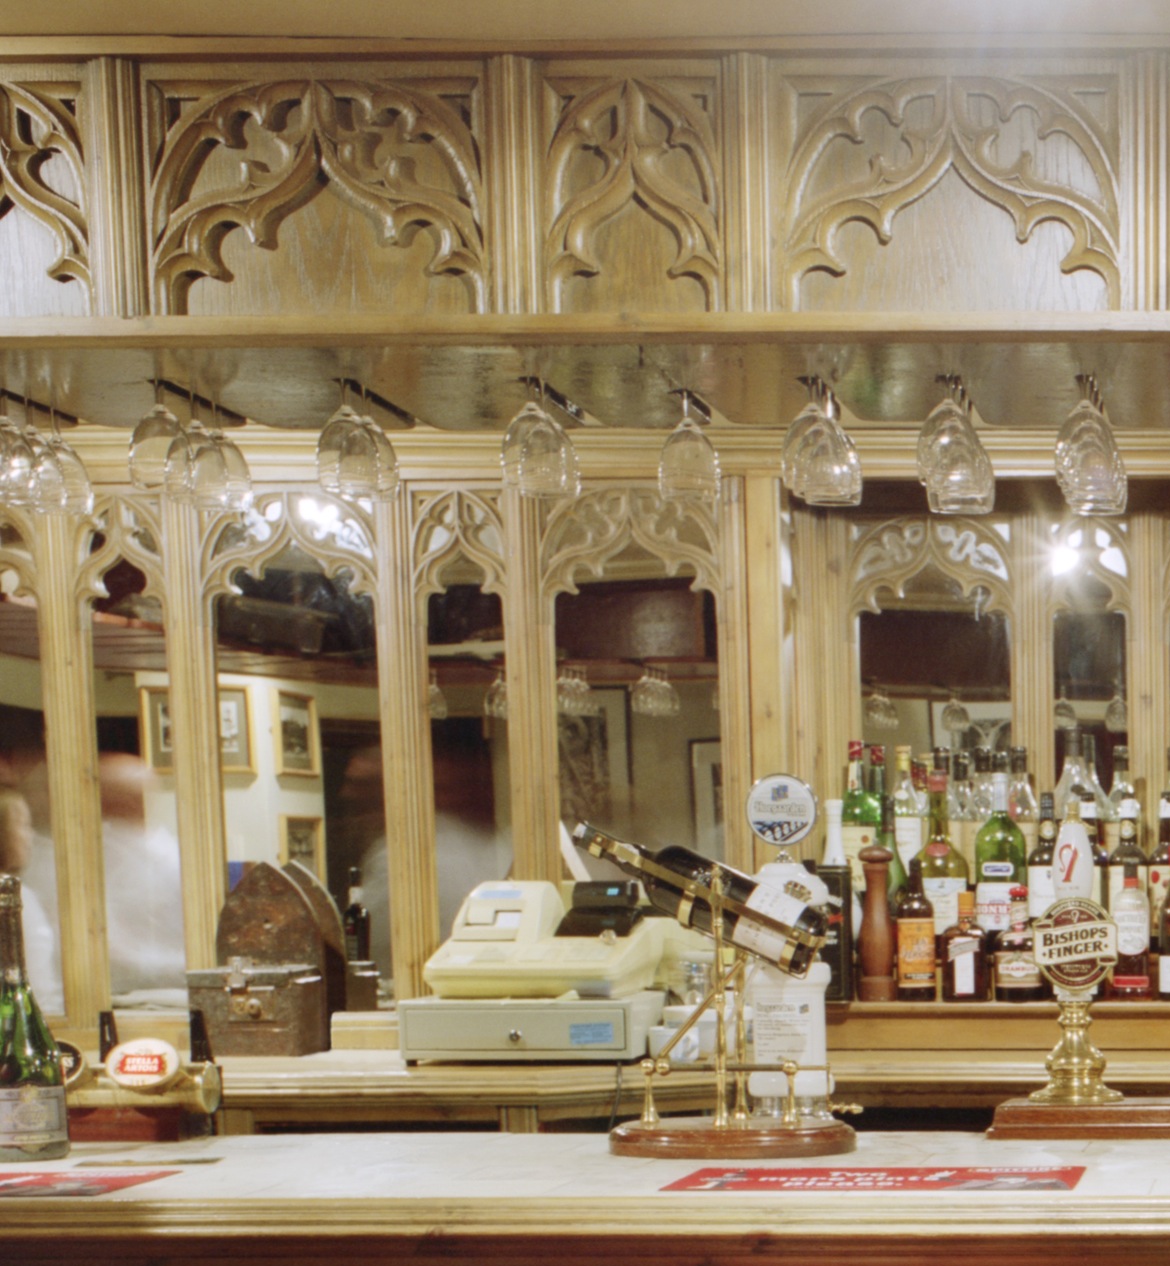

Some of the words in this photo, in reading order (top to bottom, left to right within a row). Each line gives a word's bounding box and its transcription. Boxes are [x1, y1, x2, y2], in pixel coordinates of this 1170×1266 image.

[1042, 926, 1109, 948] BISHOPS
[1047, 940, 1103, 960] FINGER
[123, 1064, 160, 1073] ARTOIS
[125, 1057, 160, 1066] STELLA
